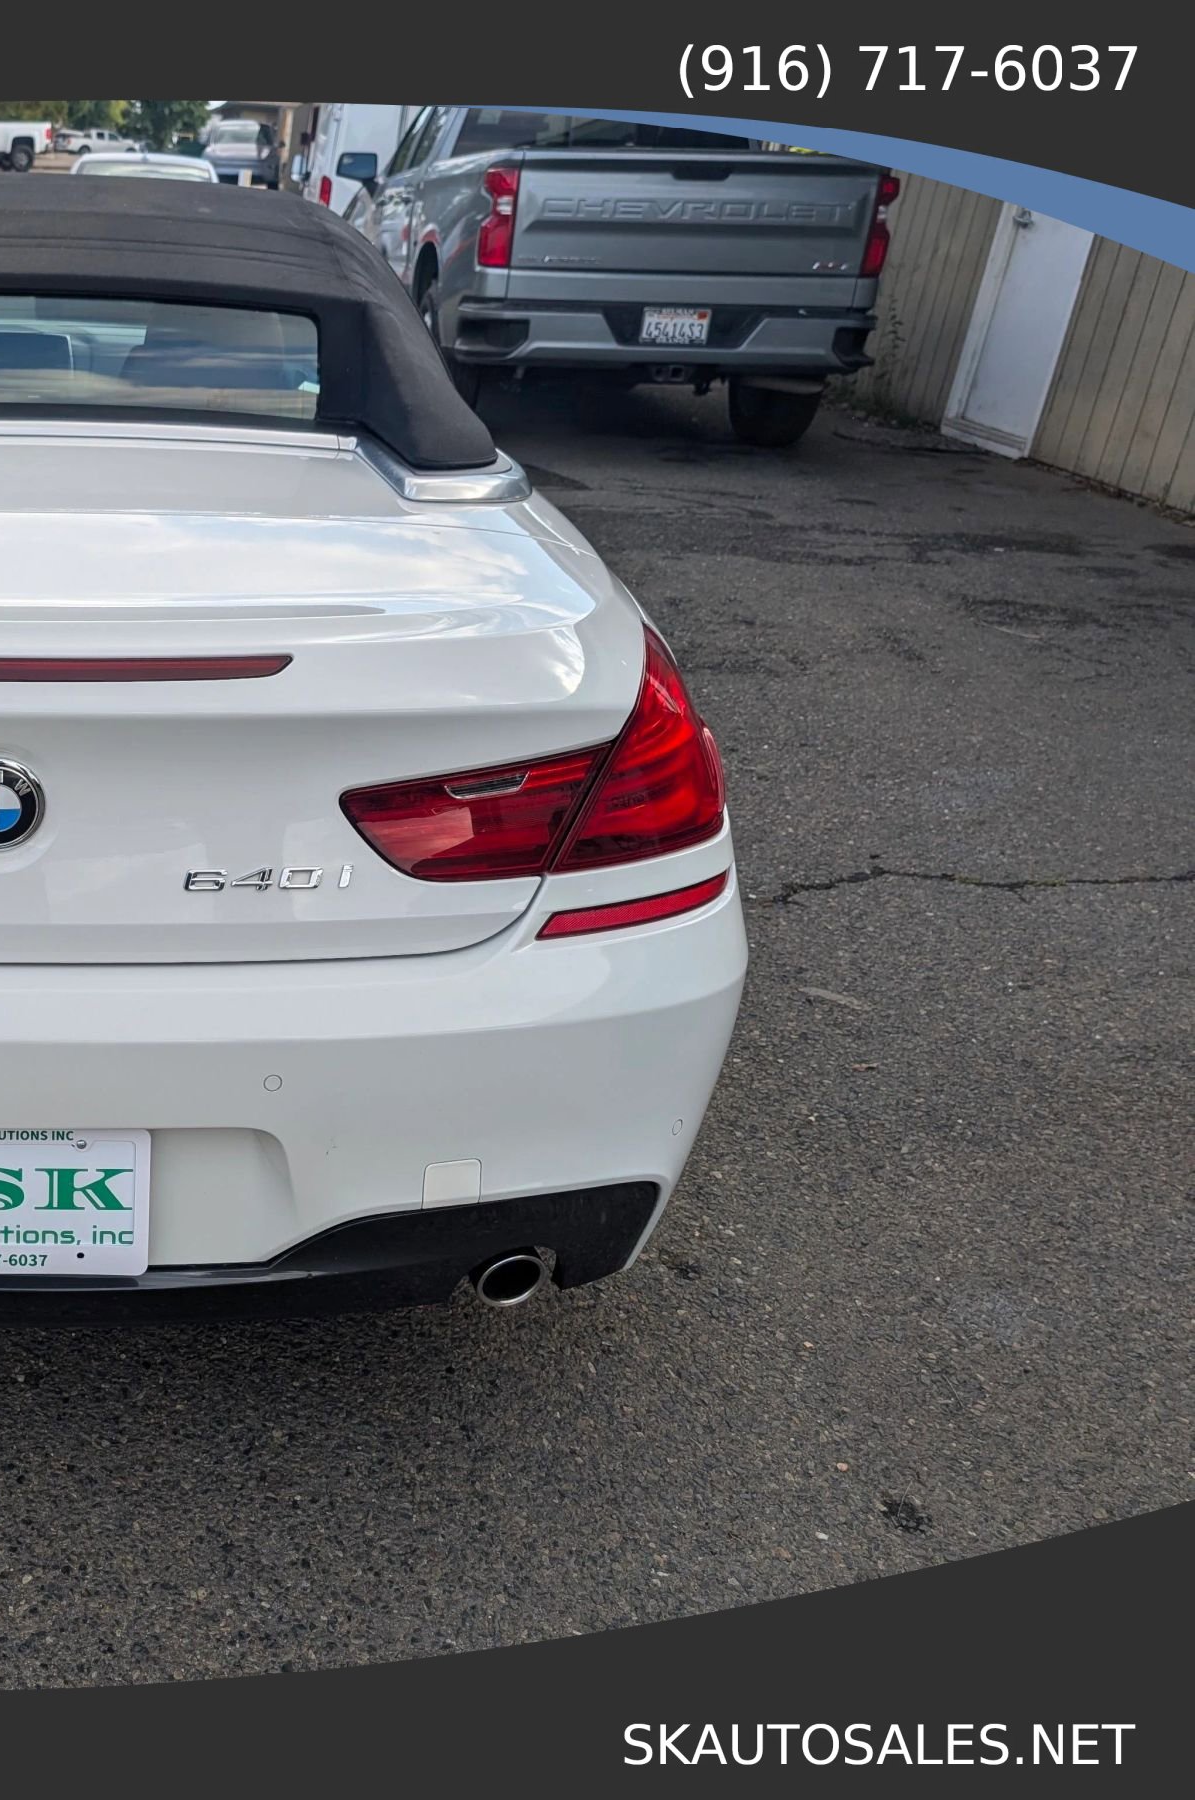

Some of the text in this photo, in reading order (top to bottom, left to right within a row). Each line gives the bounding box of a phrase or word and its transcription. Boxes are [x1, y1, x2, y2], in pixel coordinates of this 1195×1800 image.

[542, 197, 854, 224] CHEVROLET
[183, 864, 355, 892] 640i
[52, 1130, 75, 1142] INC
[92, 1225, 133, 1245] inc
